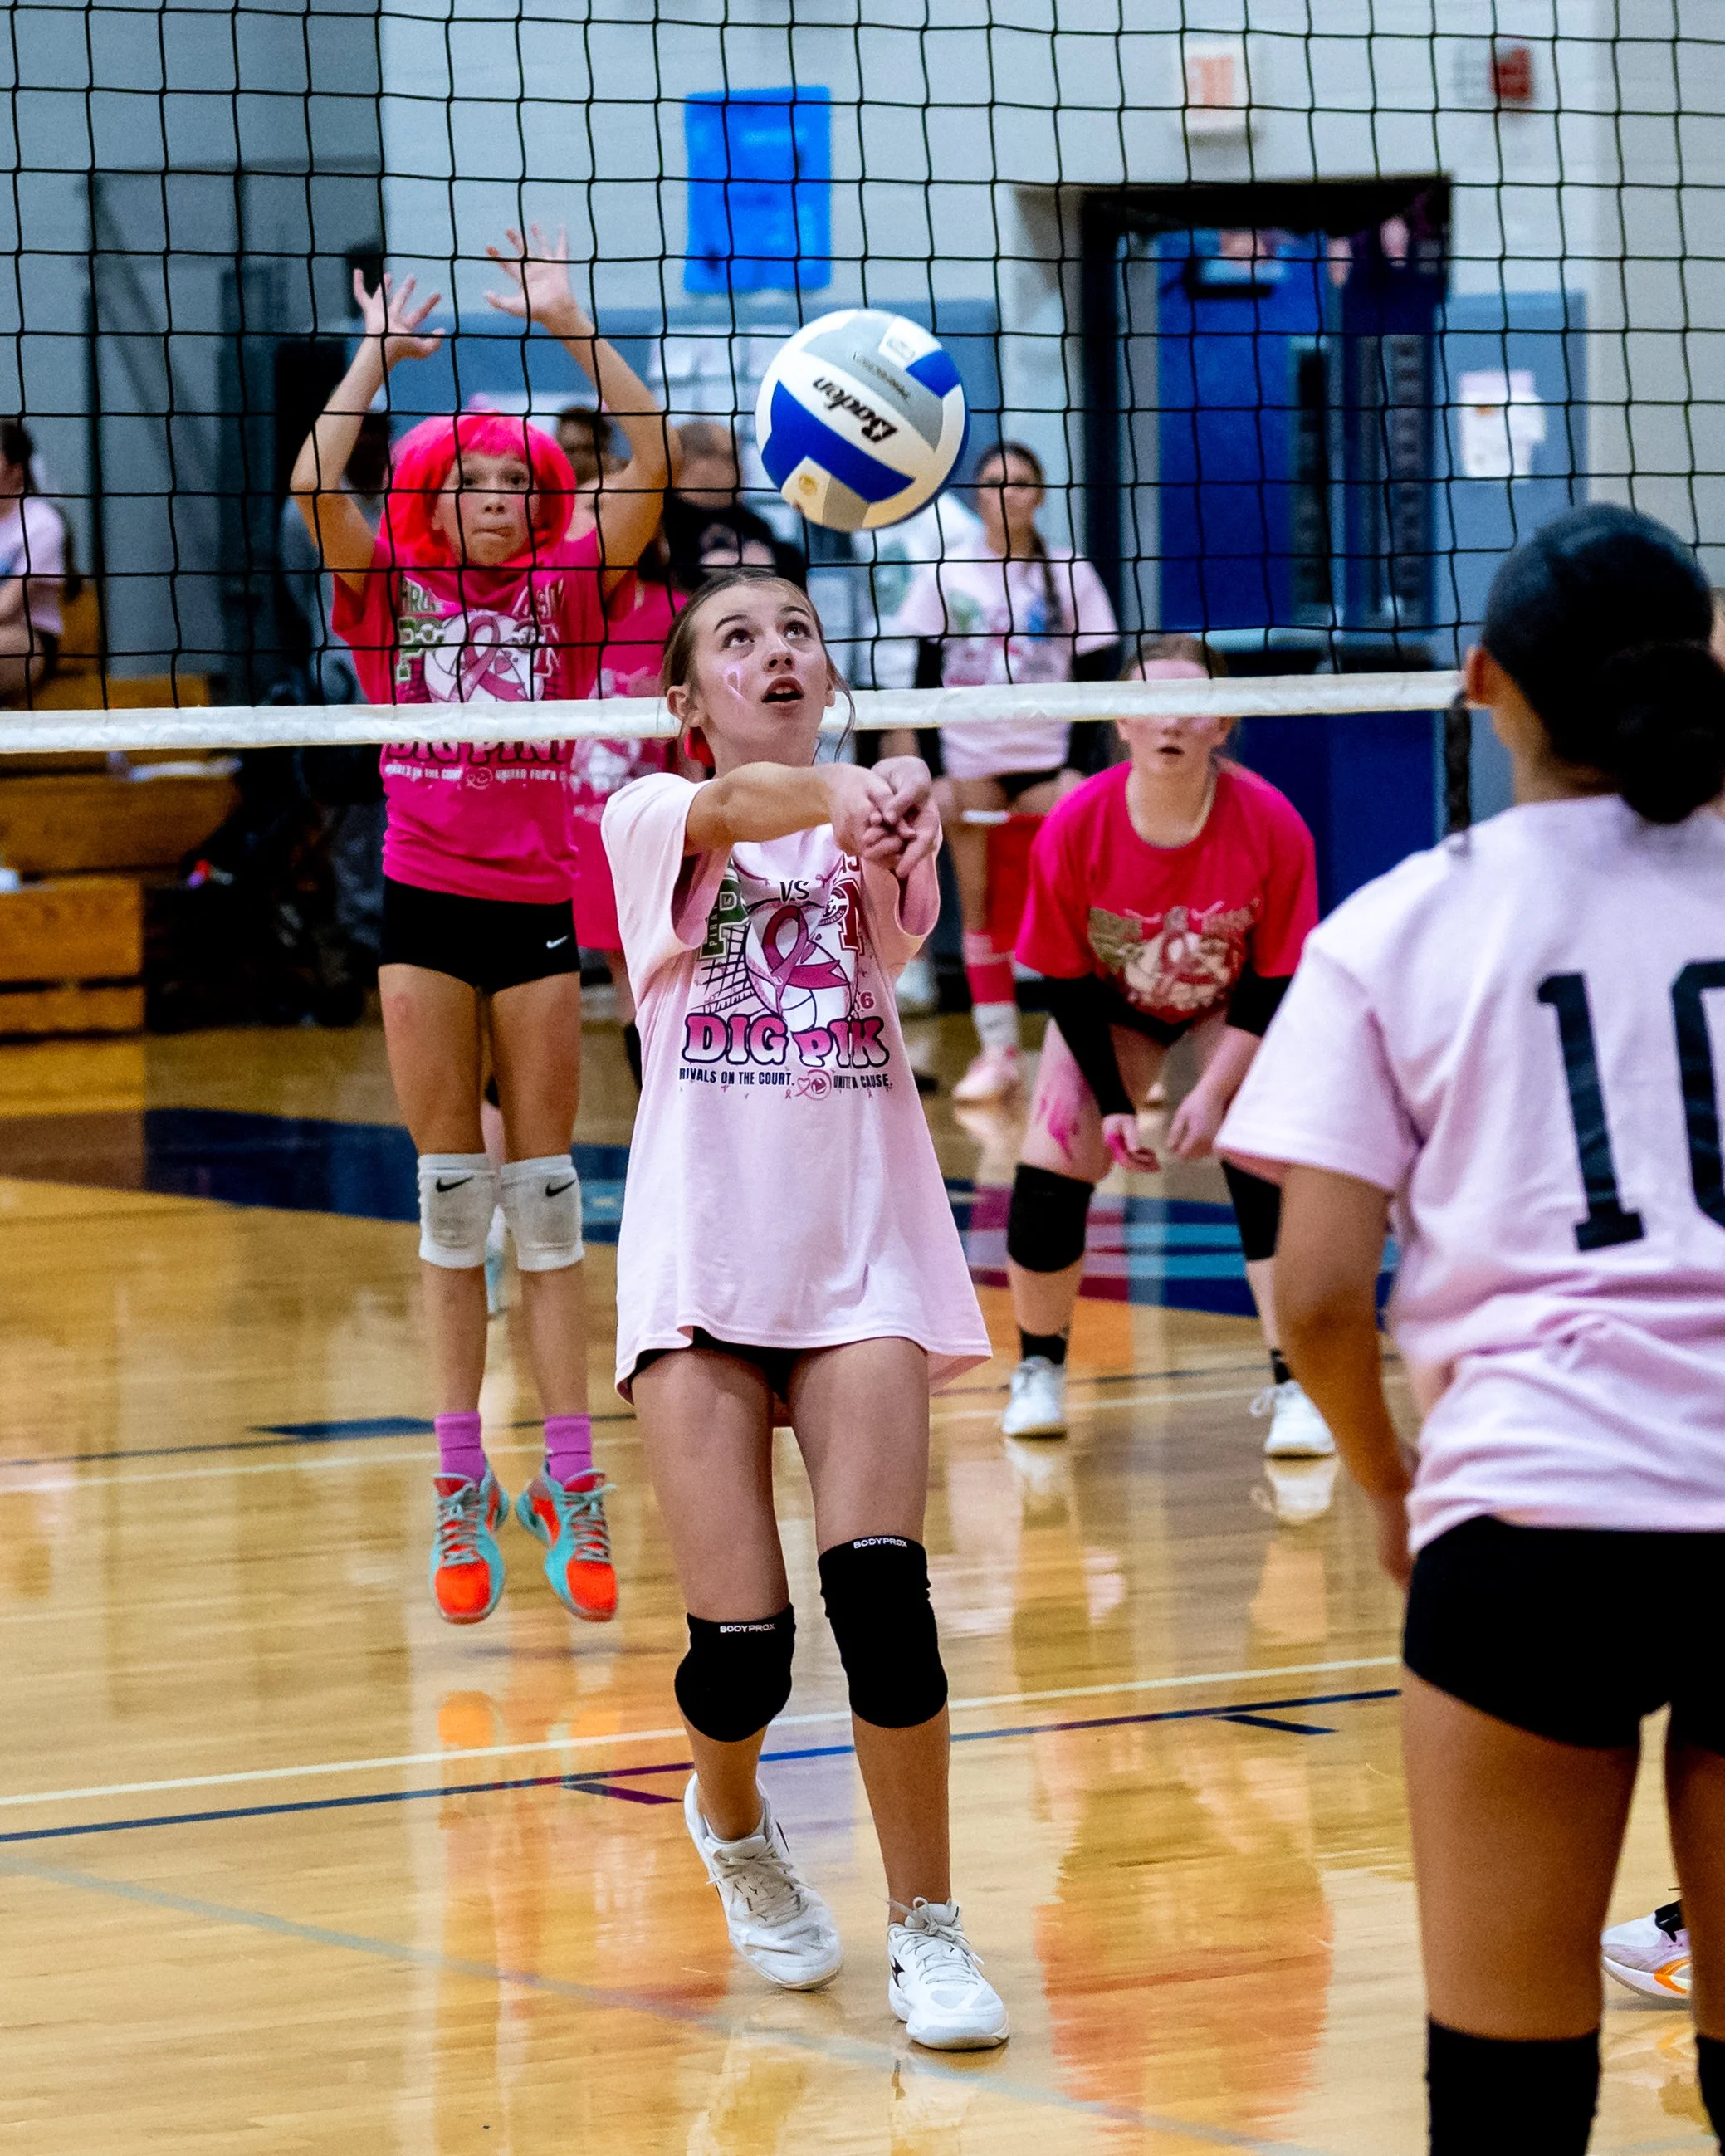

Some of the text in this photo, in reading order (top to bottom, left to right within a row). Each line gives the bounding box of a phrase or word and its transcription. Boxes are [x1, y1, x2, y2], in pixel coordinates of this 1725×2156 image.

[779, 880, 809, 902] VS
[682, 1013, 789, 1066] DIG
[679, 1068, 717, 1083] RIVALS
[721, 1071, 735, 1084] ON
[739, 1072, 755, 1085] THE
[759, 1072, 794, 1086] COURT.
[860, 1073, 893, 1088] CAUSE.
[853, 1538, 908, 1549] BODYPROX
[720, 1623, 776, 1633] BODYPROX
